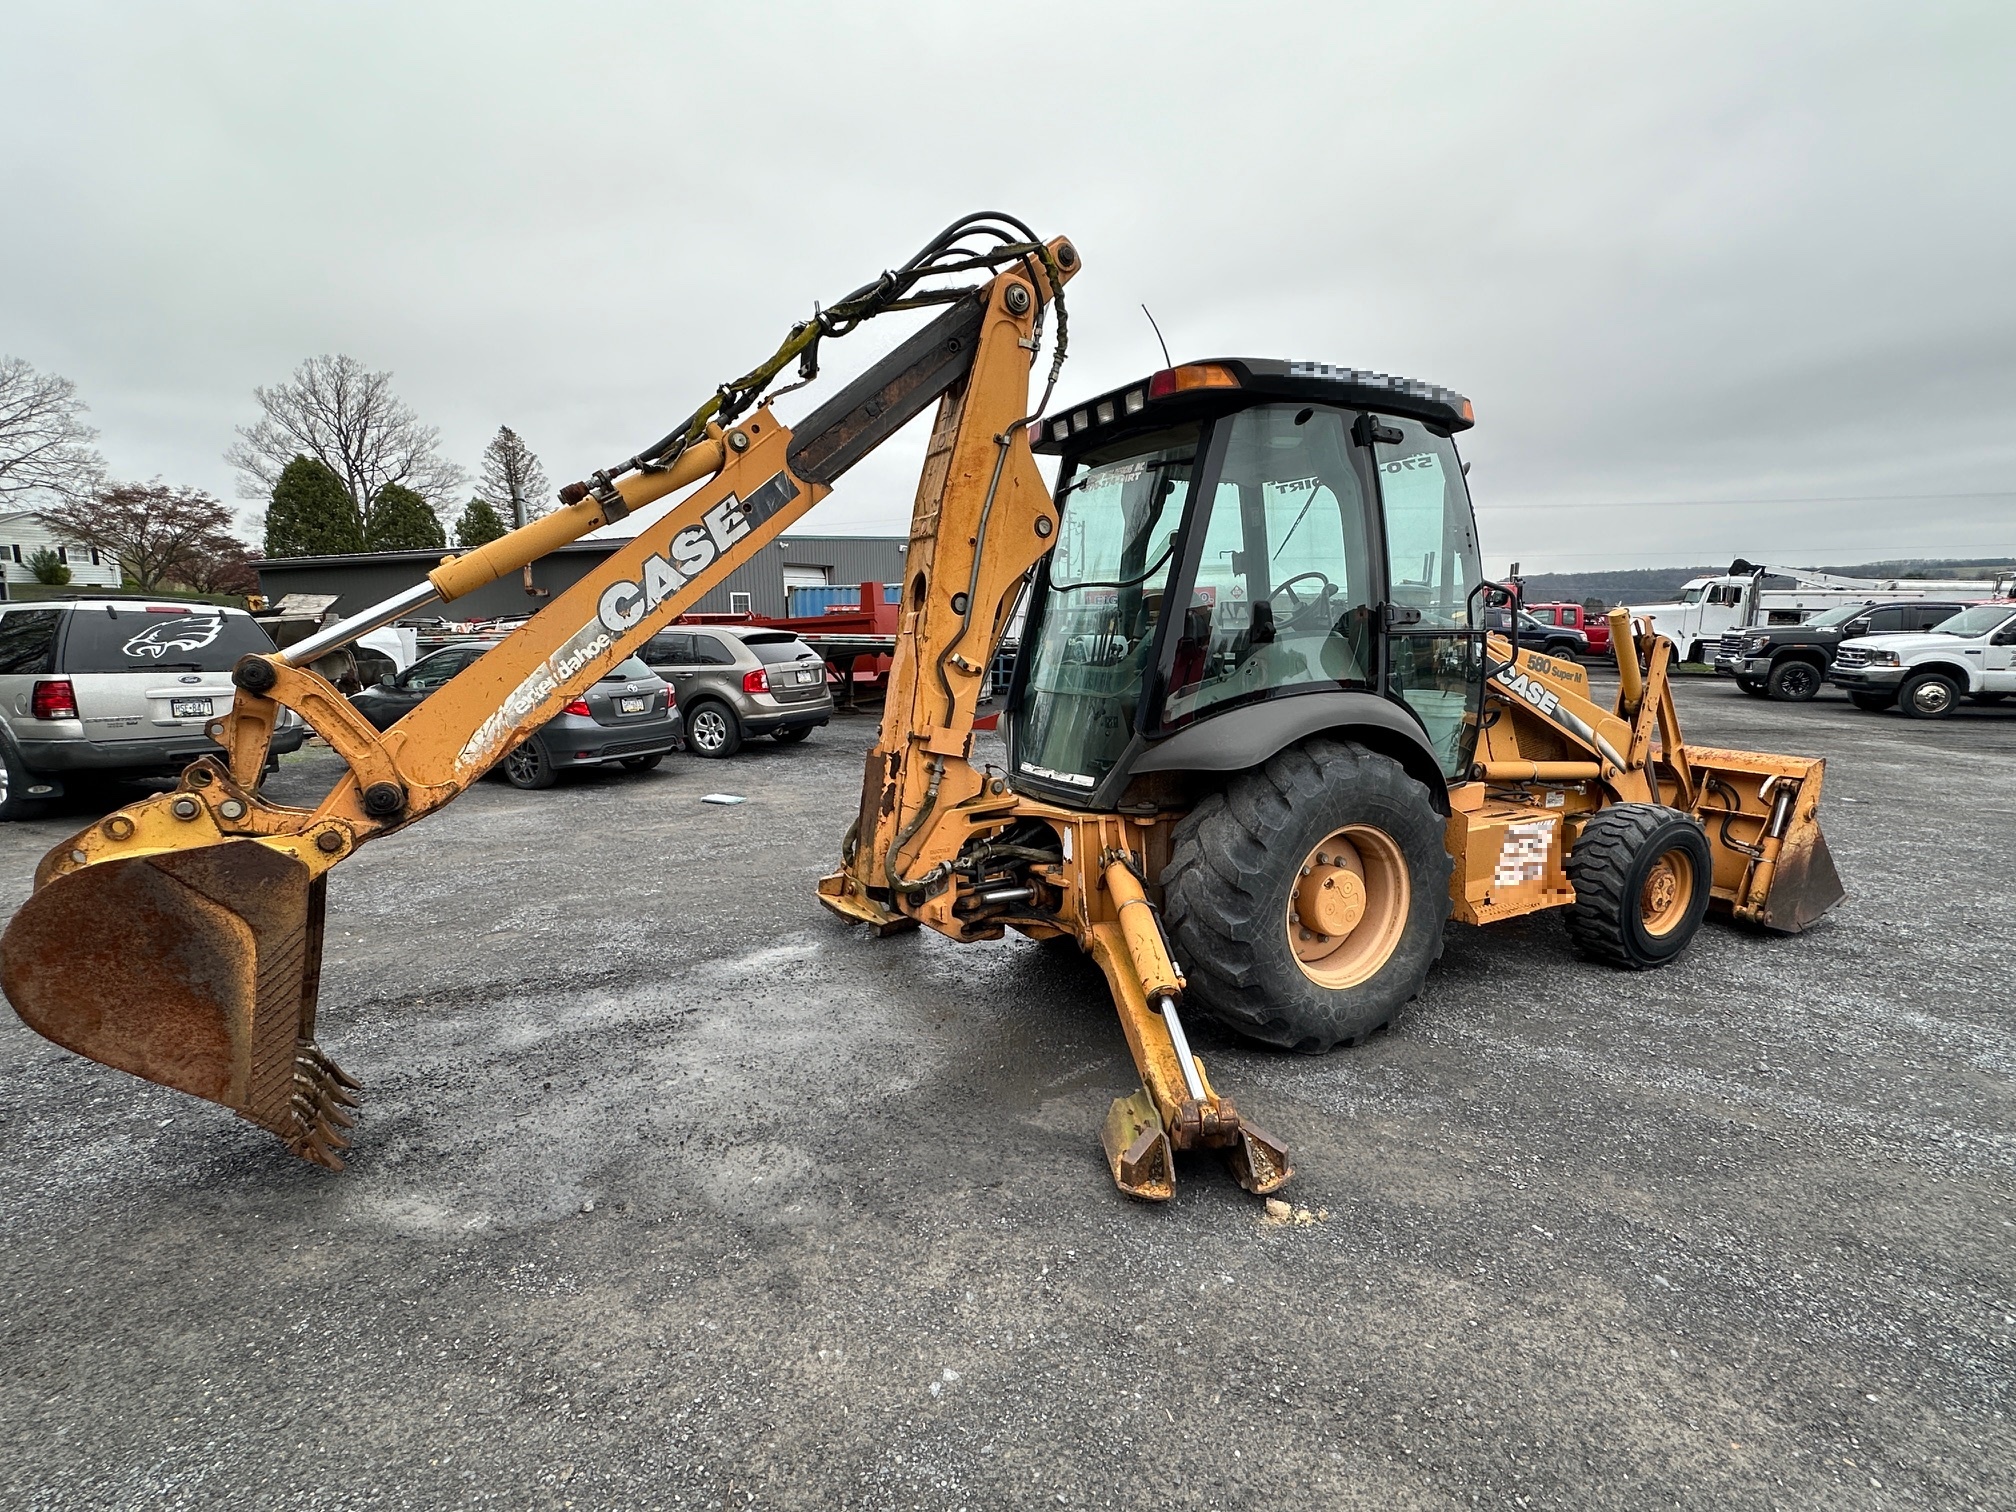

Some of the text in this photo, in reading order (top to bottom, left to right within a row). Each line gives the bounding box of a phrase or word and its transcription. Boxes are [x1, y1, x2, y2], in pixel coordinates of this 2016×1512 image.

[598, 492, 752, 632] CASE
[1496, 661, 1560, 716] CASE
[1527, 654, 1582, 683] 580 Super M
